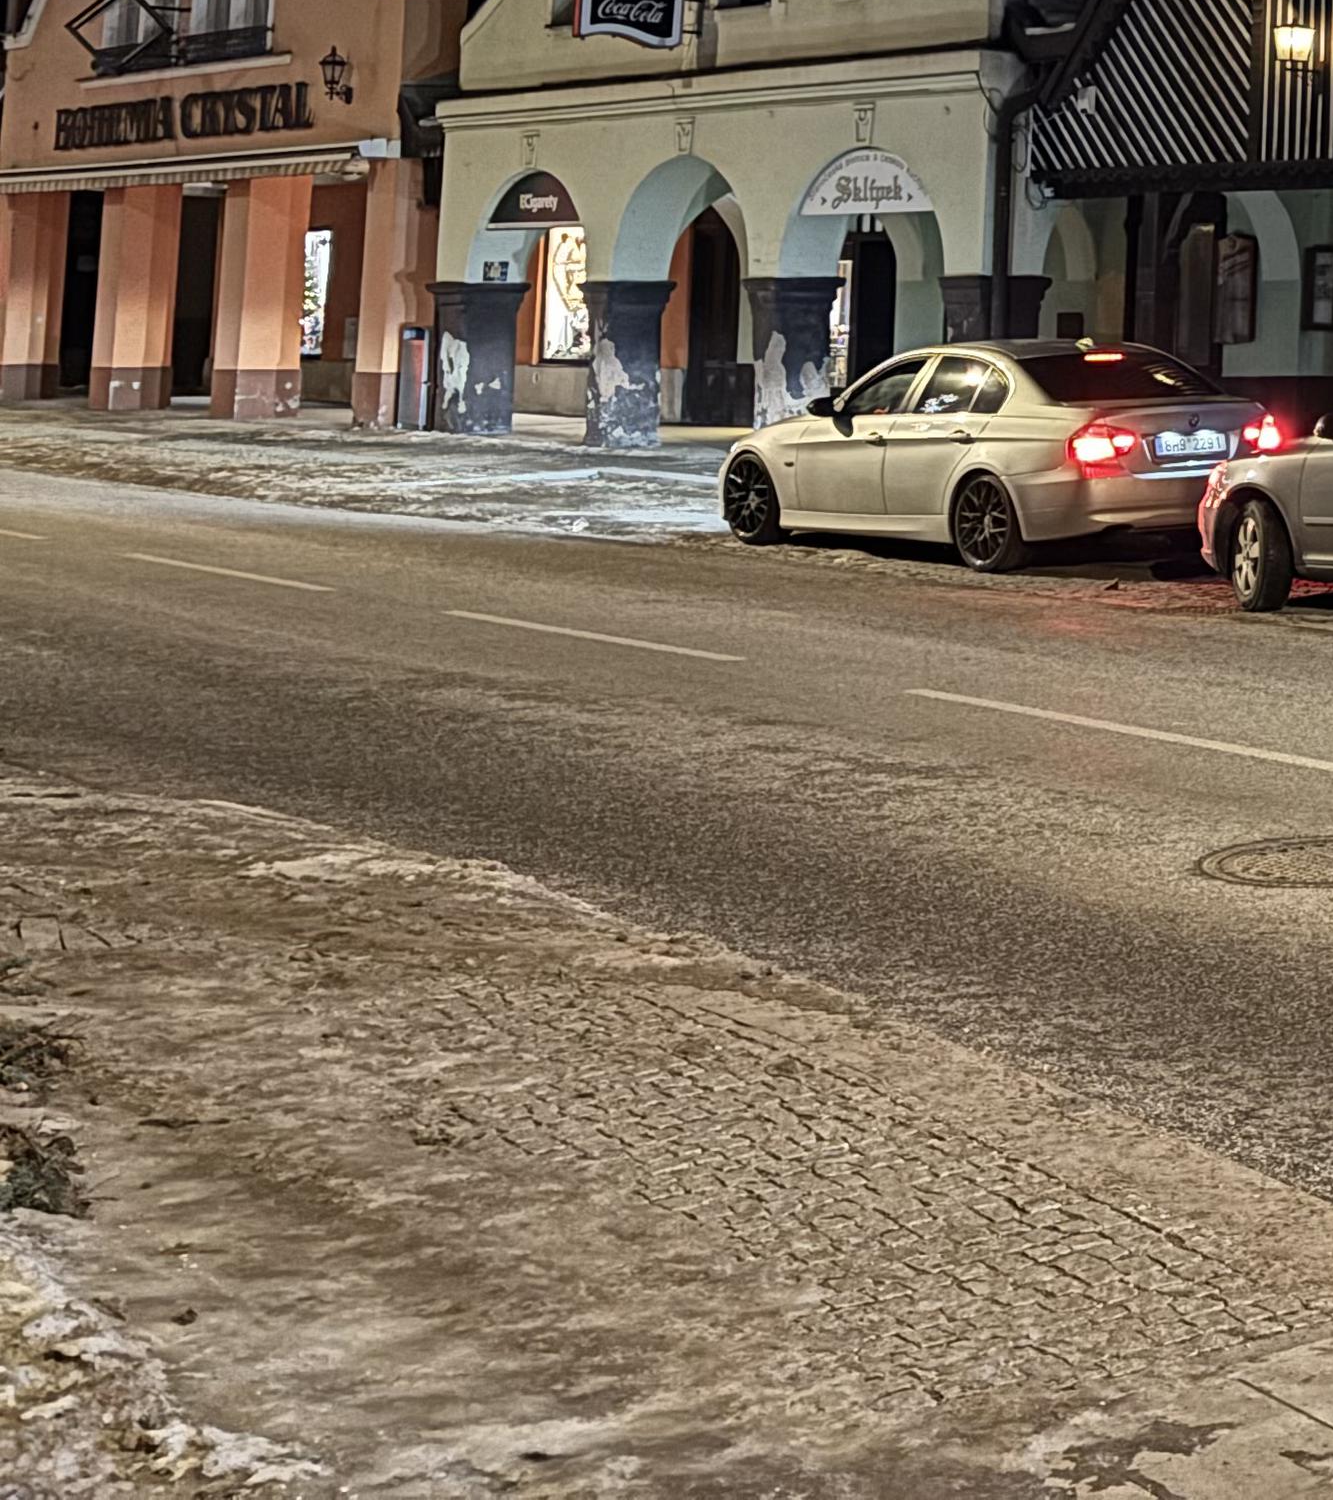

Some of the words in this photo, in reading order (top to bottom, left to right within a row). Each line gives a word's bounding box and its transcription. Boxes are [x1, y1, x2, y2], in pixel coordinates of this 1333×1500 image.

[54, 95, 177, 150] BOHEMIA
[180, 82, 314, 139] CRYSTAL
[1193, 436, 1221, 450] 2291
